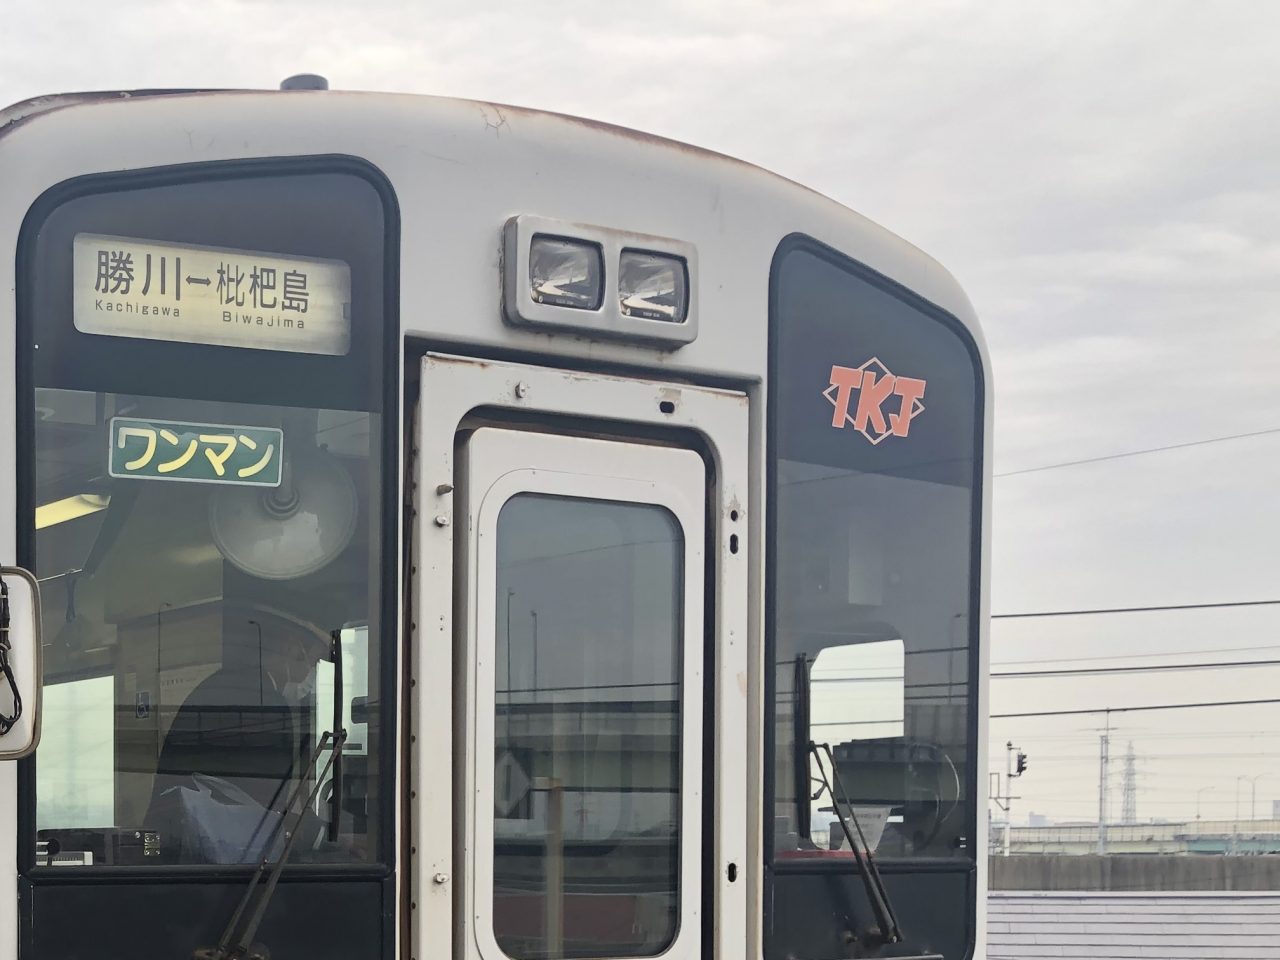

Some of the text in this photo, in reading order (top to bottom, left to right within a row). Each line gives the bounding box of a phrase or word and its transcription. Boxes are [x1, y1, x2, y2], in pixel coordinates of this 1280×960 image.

[94, 250, 309, 314] 勝川 枇杷島
[95, 299, 181, 317] Kachigawa
[222, 310, 305, 329] Biwajima
[829, 365, 926, 437] TKJ
[117, 427, 274, 478] ワンマン
